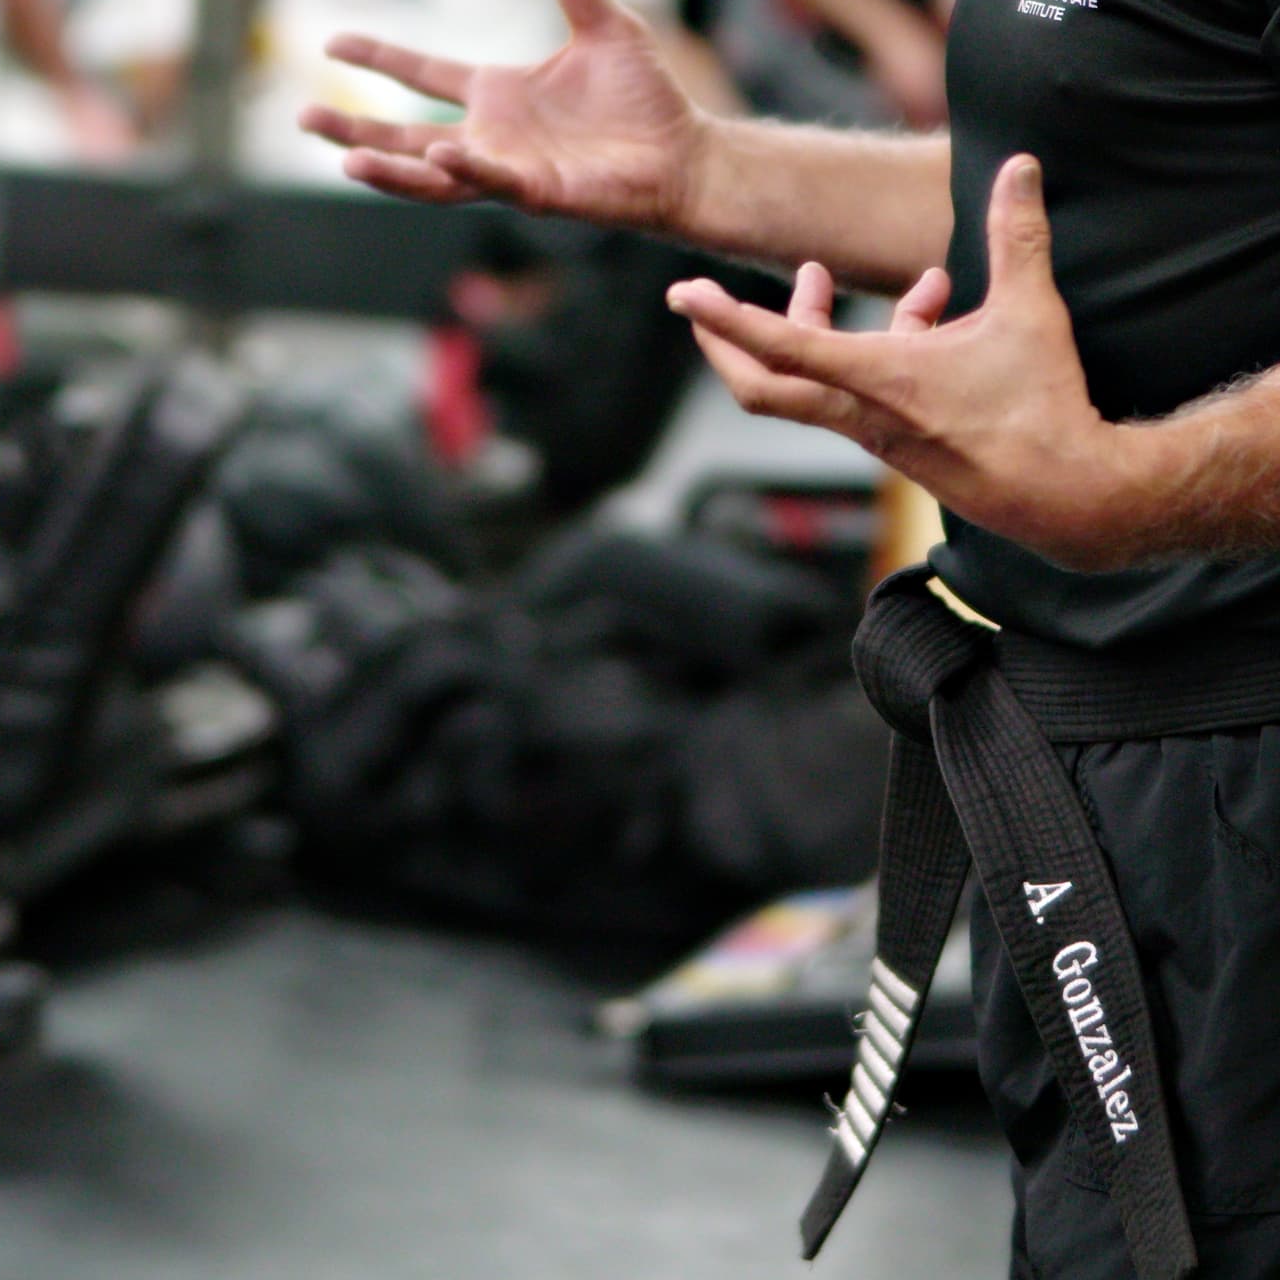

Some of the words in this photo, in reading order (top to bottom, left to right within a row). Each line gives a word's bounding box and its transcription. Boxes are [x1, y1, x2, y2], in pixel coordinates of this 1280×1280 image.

[1017, 0, 1066, 21] INSTITUTE
[1023, 880, 1072, 925] A.
[1052, 940, 1139, 1144] Gonzalez
